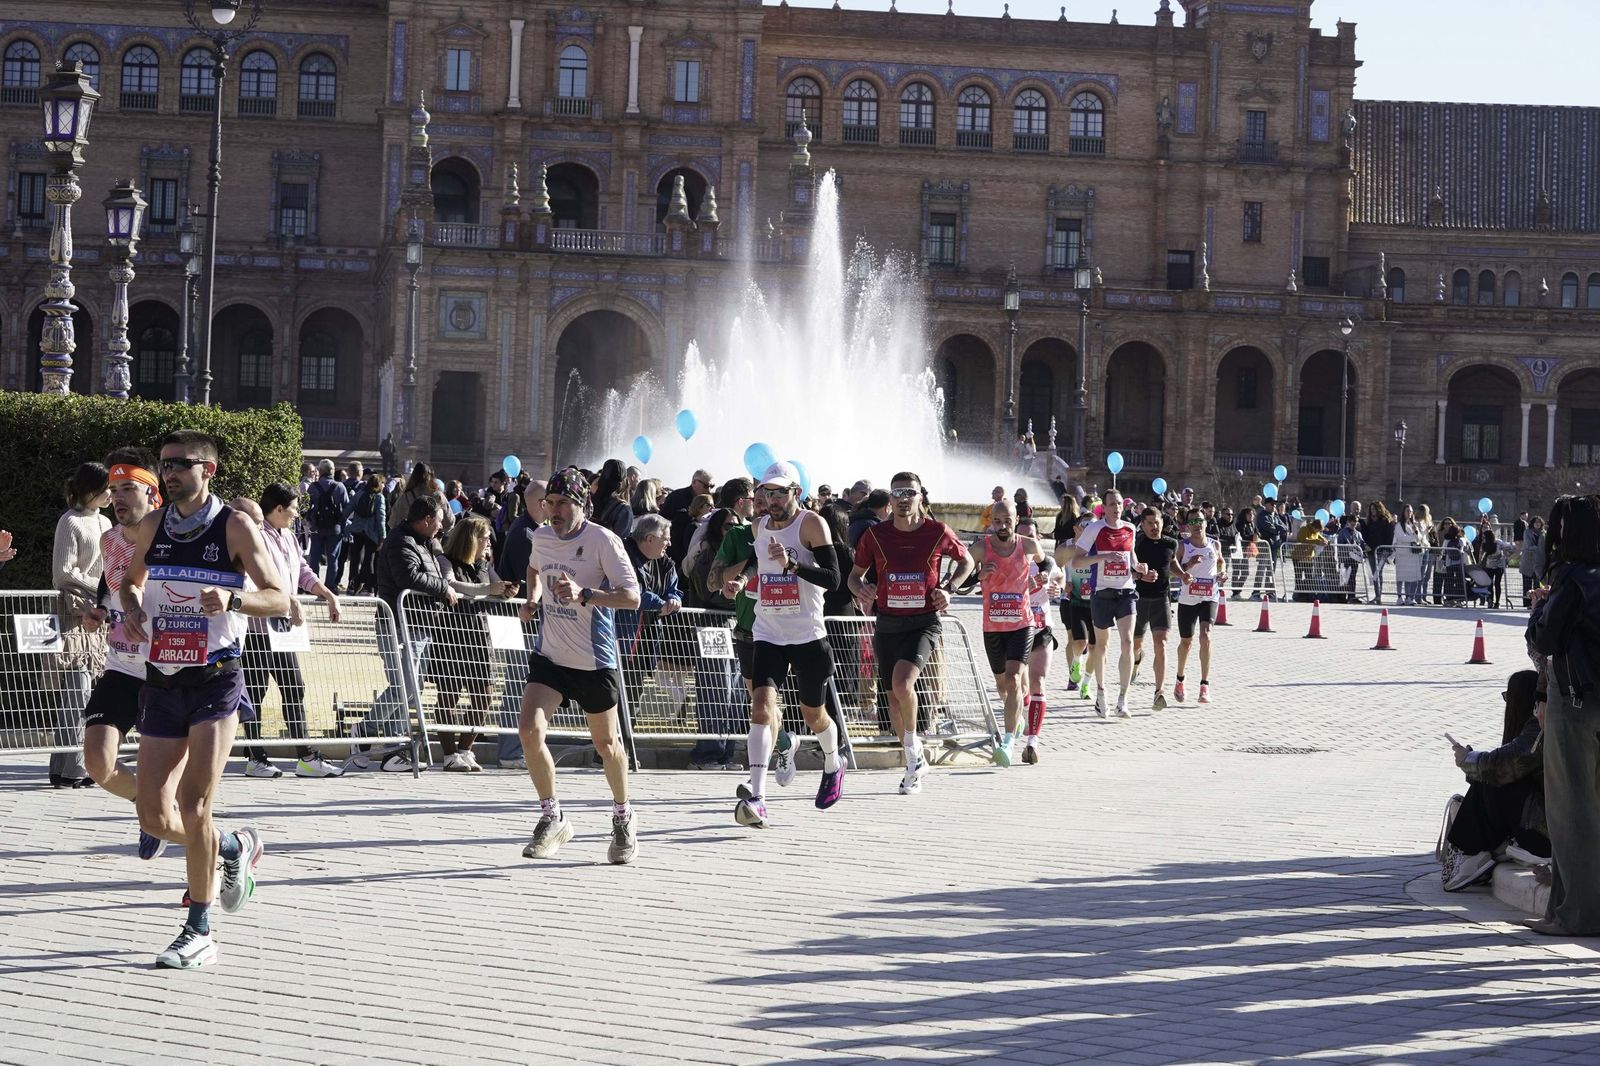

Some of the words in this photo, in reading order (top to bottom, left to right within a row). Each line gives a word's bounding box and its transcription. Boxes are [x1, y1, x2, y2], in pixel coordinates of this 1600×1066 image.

[158, 604, 205, 614] YANDIOLA
[26, 620, 51, 636] AMS
[168, 620, 201, 629] ZURICH
[168, 638, 186, 646] 1359
[705, 631, 723, 644] AMS
[158, 649, 198, 662] ARRAZU
